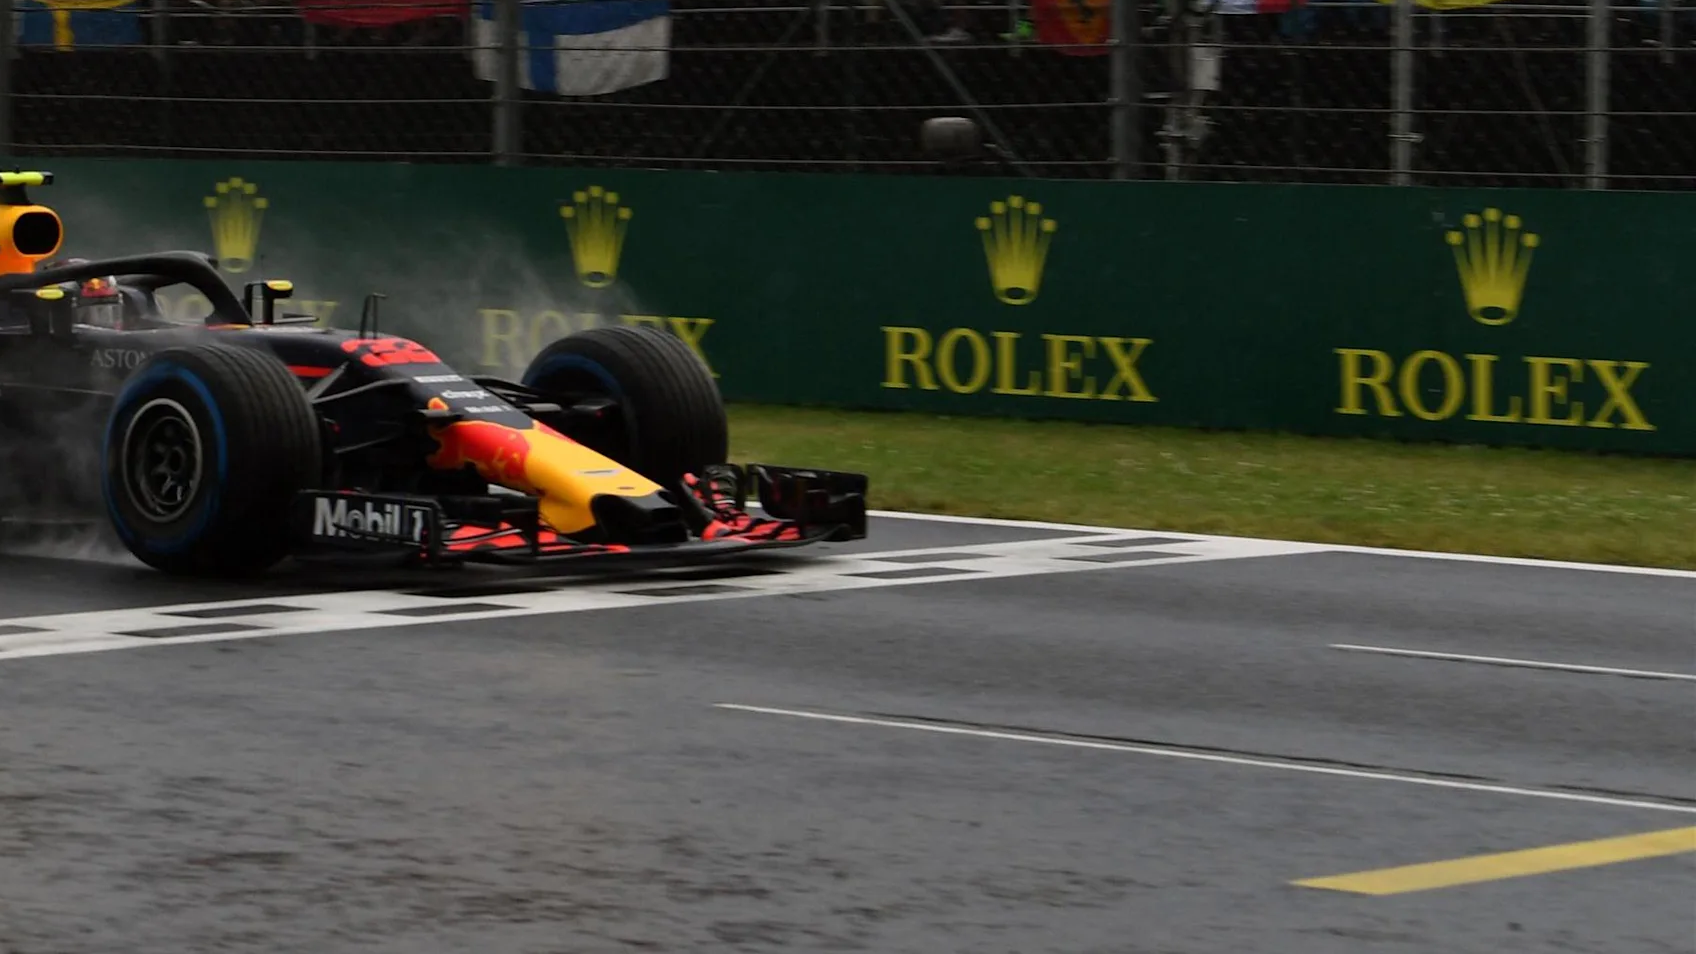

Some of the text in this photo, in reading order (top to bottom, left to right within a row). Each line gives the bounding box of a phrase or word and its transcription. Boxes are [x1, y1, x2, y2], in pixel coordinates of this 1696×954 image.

[880, 325, 1159, 403] ROLEX
[1334, 347, 1656, 431] ROLEX
[313, 497, 424, 542] Mobil 1
